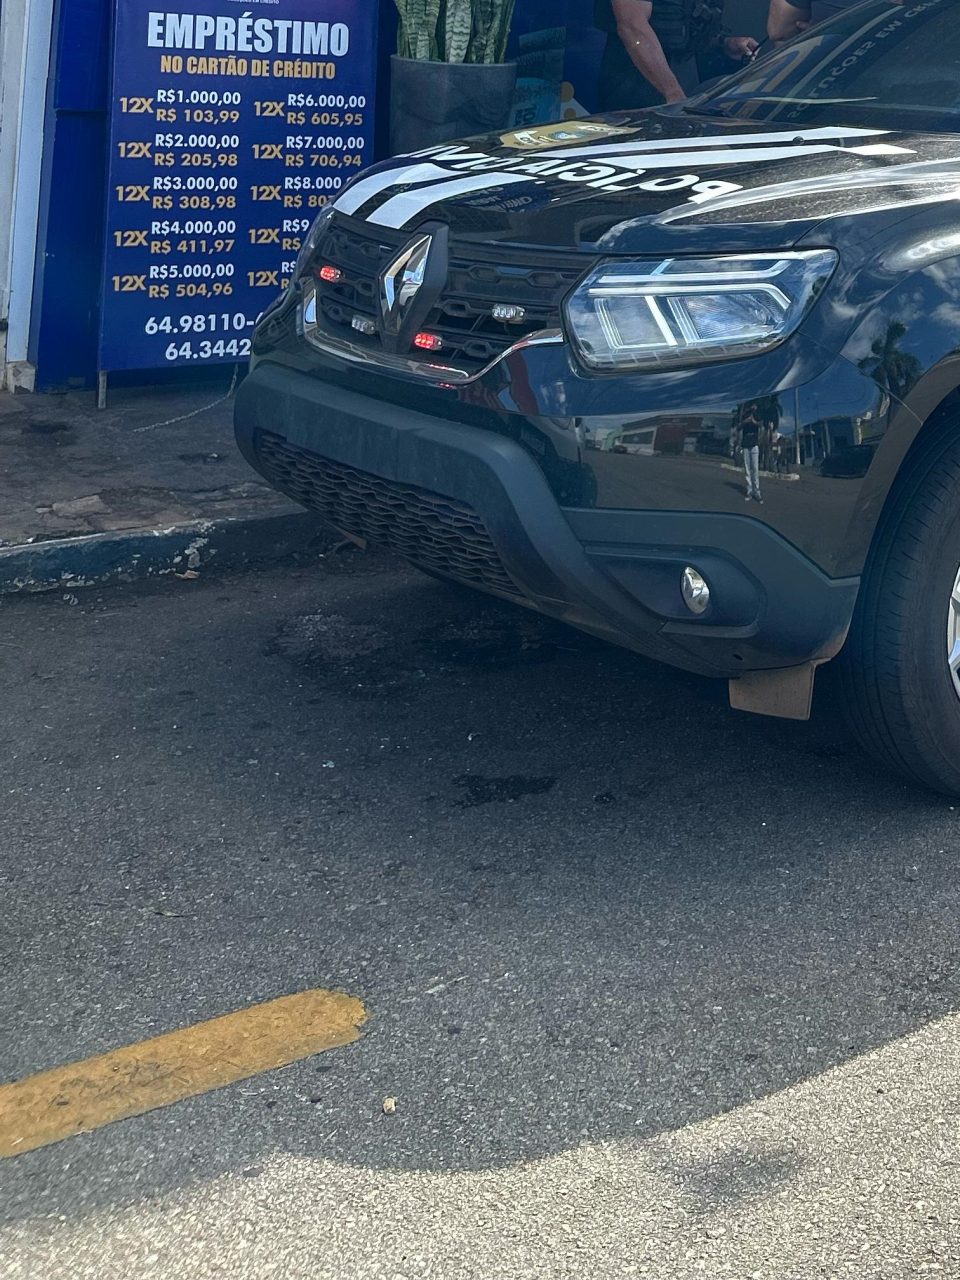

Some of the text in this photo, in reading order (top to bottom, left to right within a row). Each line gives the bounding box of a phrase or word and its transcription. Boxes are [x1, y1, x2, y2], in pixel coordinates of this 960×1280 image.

[148, 11, 350, 57] EMPRÉSTIMO
[160, 55, 336, 80] NO CARTÃO DE CRÉDITO
[156, 89, 241, 105] R$1.000,00
[288, 94, 366, 109] R$6.000,00
[119, 97, 154, 114] 12X
[254, 101, 285, 117] 12X
[156, 108, 240, 124] R$ 103,99
[287, 112, 363, 127] R$ 605,95
[155, 133, 240, 149] R$2.000,00
[286, 135, 364, 151] R$7.000,00
[117, 142, 152, 158] 12X
[252, 144, 283, 159] 12X
[154, 152, 238, 168] R$ 205,98
[285, 154, 362, 168] R$ 706,94
[153, 176, 238, 191] R$3.000,00
[284, 176, 351, 191] R$8.000
[115, 185, 150, 201] 12X
[250, 185, 282, 201] 12X
[152, 195, 236, 210] R$ 308,98
[284, 194, 302, 209] R$
[151, 220, 236, 236] R$4.000,00
[248, 228, 280, 244] 12X
[113, 230, 149, 247] 12X
[151, 239, 235, 255] R$ 411,97
[149, 263, 234, 280] R$5.000,00
[247, 271, 278, 287] 12X
[112, 275, 147, 291] 12X
[149, 283, 233, 299] R$ 504,96
[165, 338, 251, 361] 64.3442
